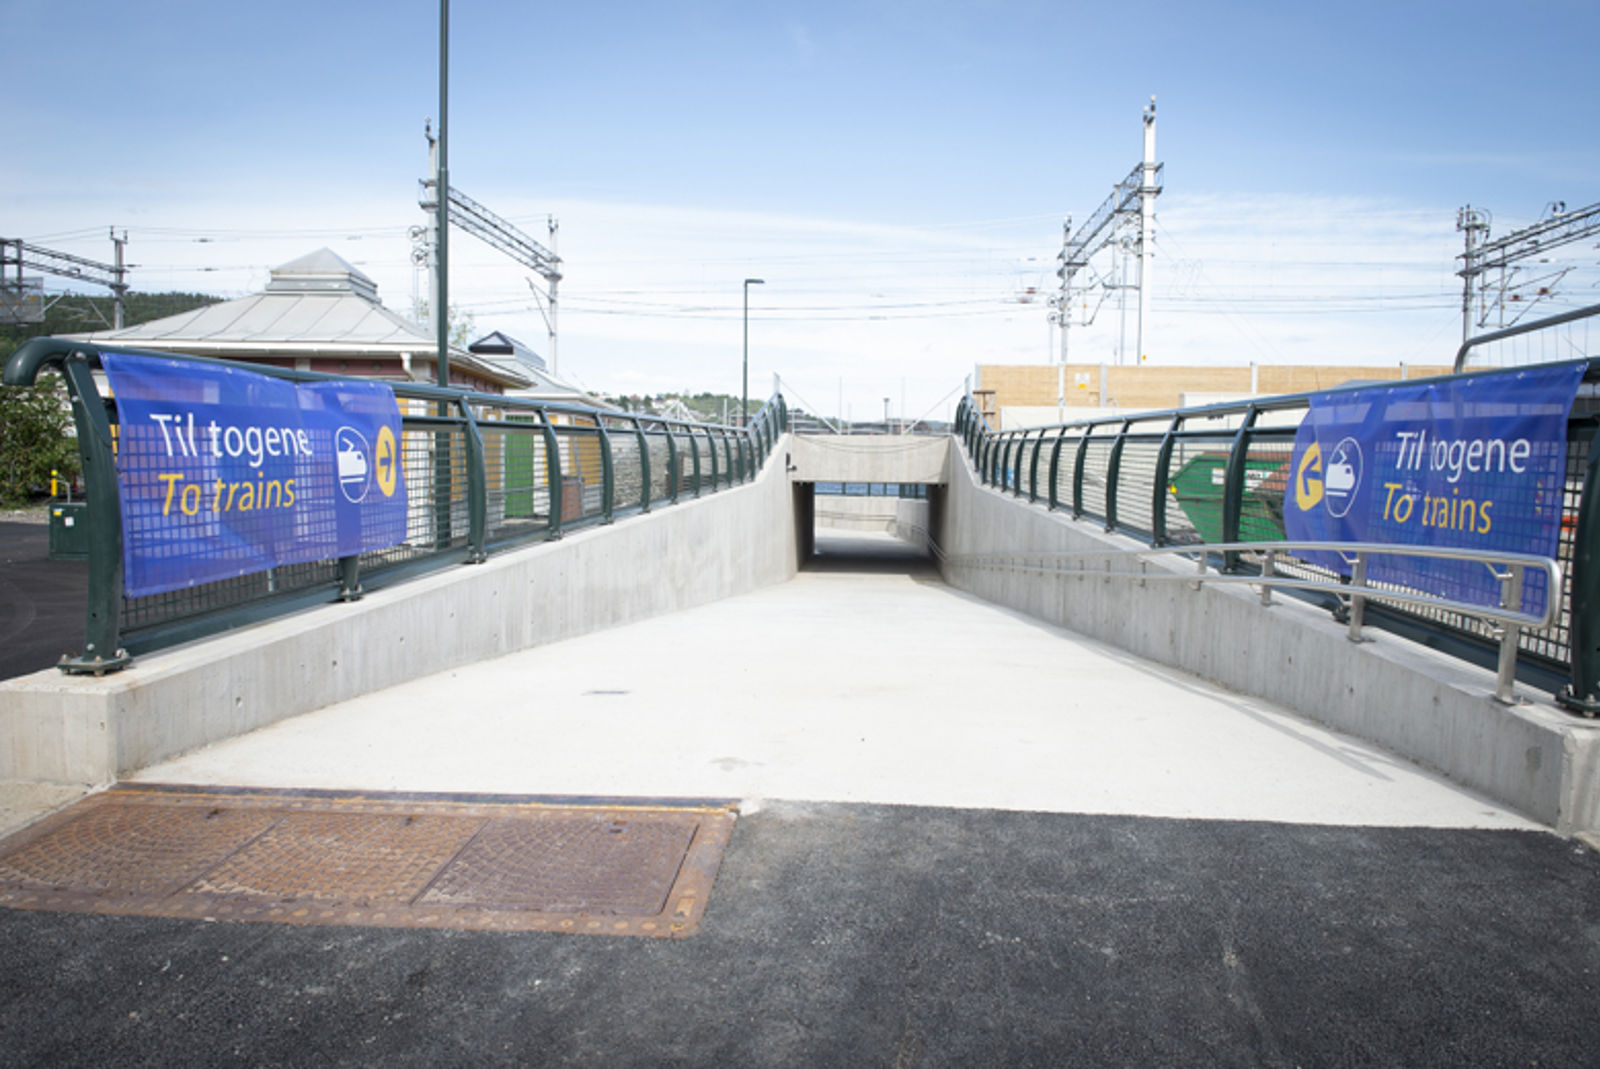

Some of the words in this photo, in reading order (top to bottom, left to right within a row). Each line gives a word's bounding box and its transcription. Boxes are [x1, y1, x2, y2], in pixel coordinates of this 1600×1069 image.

[149, 412, 198, 457] Til
[209, 420, 313, 467] togene
[1397, 429, 1426, 470] Til
[1430, 437, 1530, 483] togene
[158, 473, 200, 516] To
[212, 471, 296, 512] trains
[1384, 483, 1414, 523] To
[1422, 488, 1493, 534] trains
